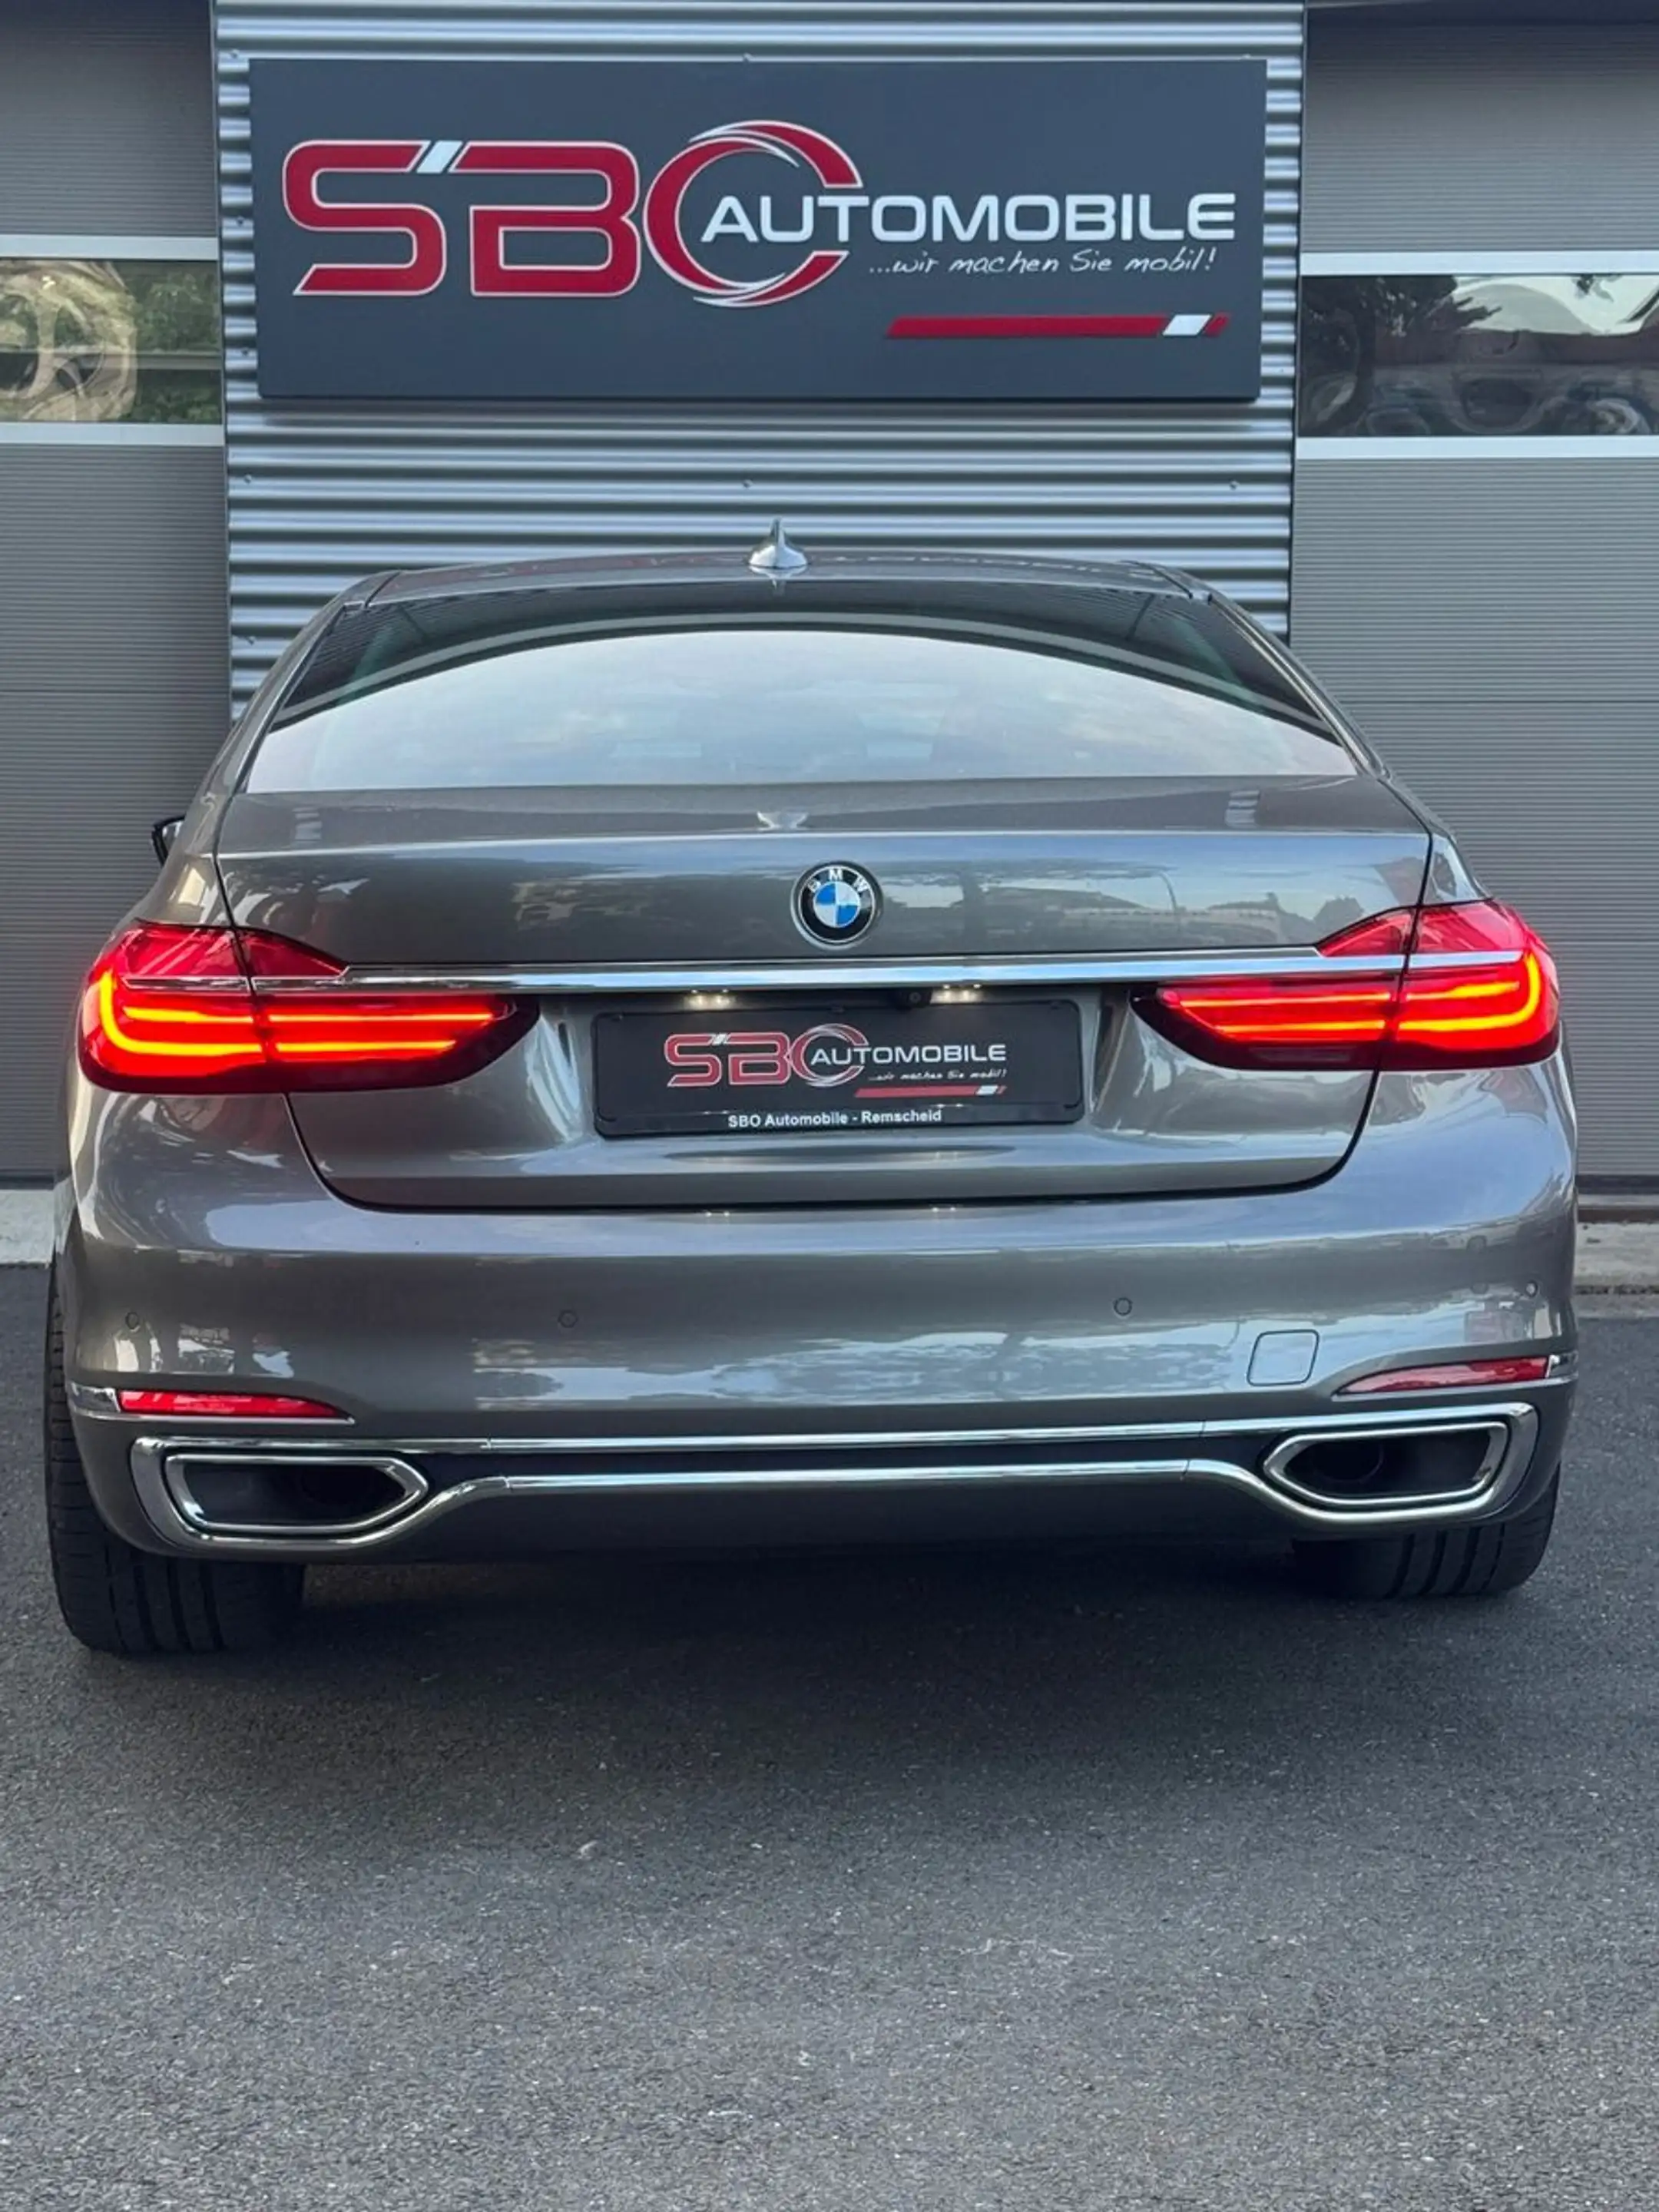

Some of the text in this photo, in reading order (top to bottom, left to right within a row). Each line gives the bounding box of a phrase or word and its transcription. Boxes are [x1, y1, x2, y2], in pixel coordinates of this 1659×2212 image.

[700, 193, 1236, 243] AUTOMOBILE
[949, 250, 1060, 273] machen
[1069, 248, 1113, 273] Sie
[1124, 246, 1218, 272] mobil!
[807, 867, 871, 893] BMW
[810, 1044, 1007, 1067] AUTOMOBILE
[728, 1114, 761, 1128] SBO
[764, 1111, 849, 1128] Automobile
[861, 1109, 942, 1124] Remscheid
